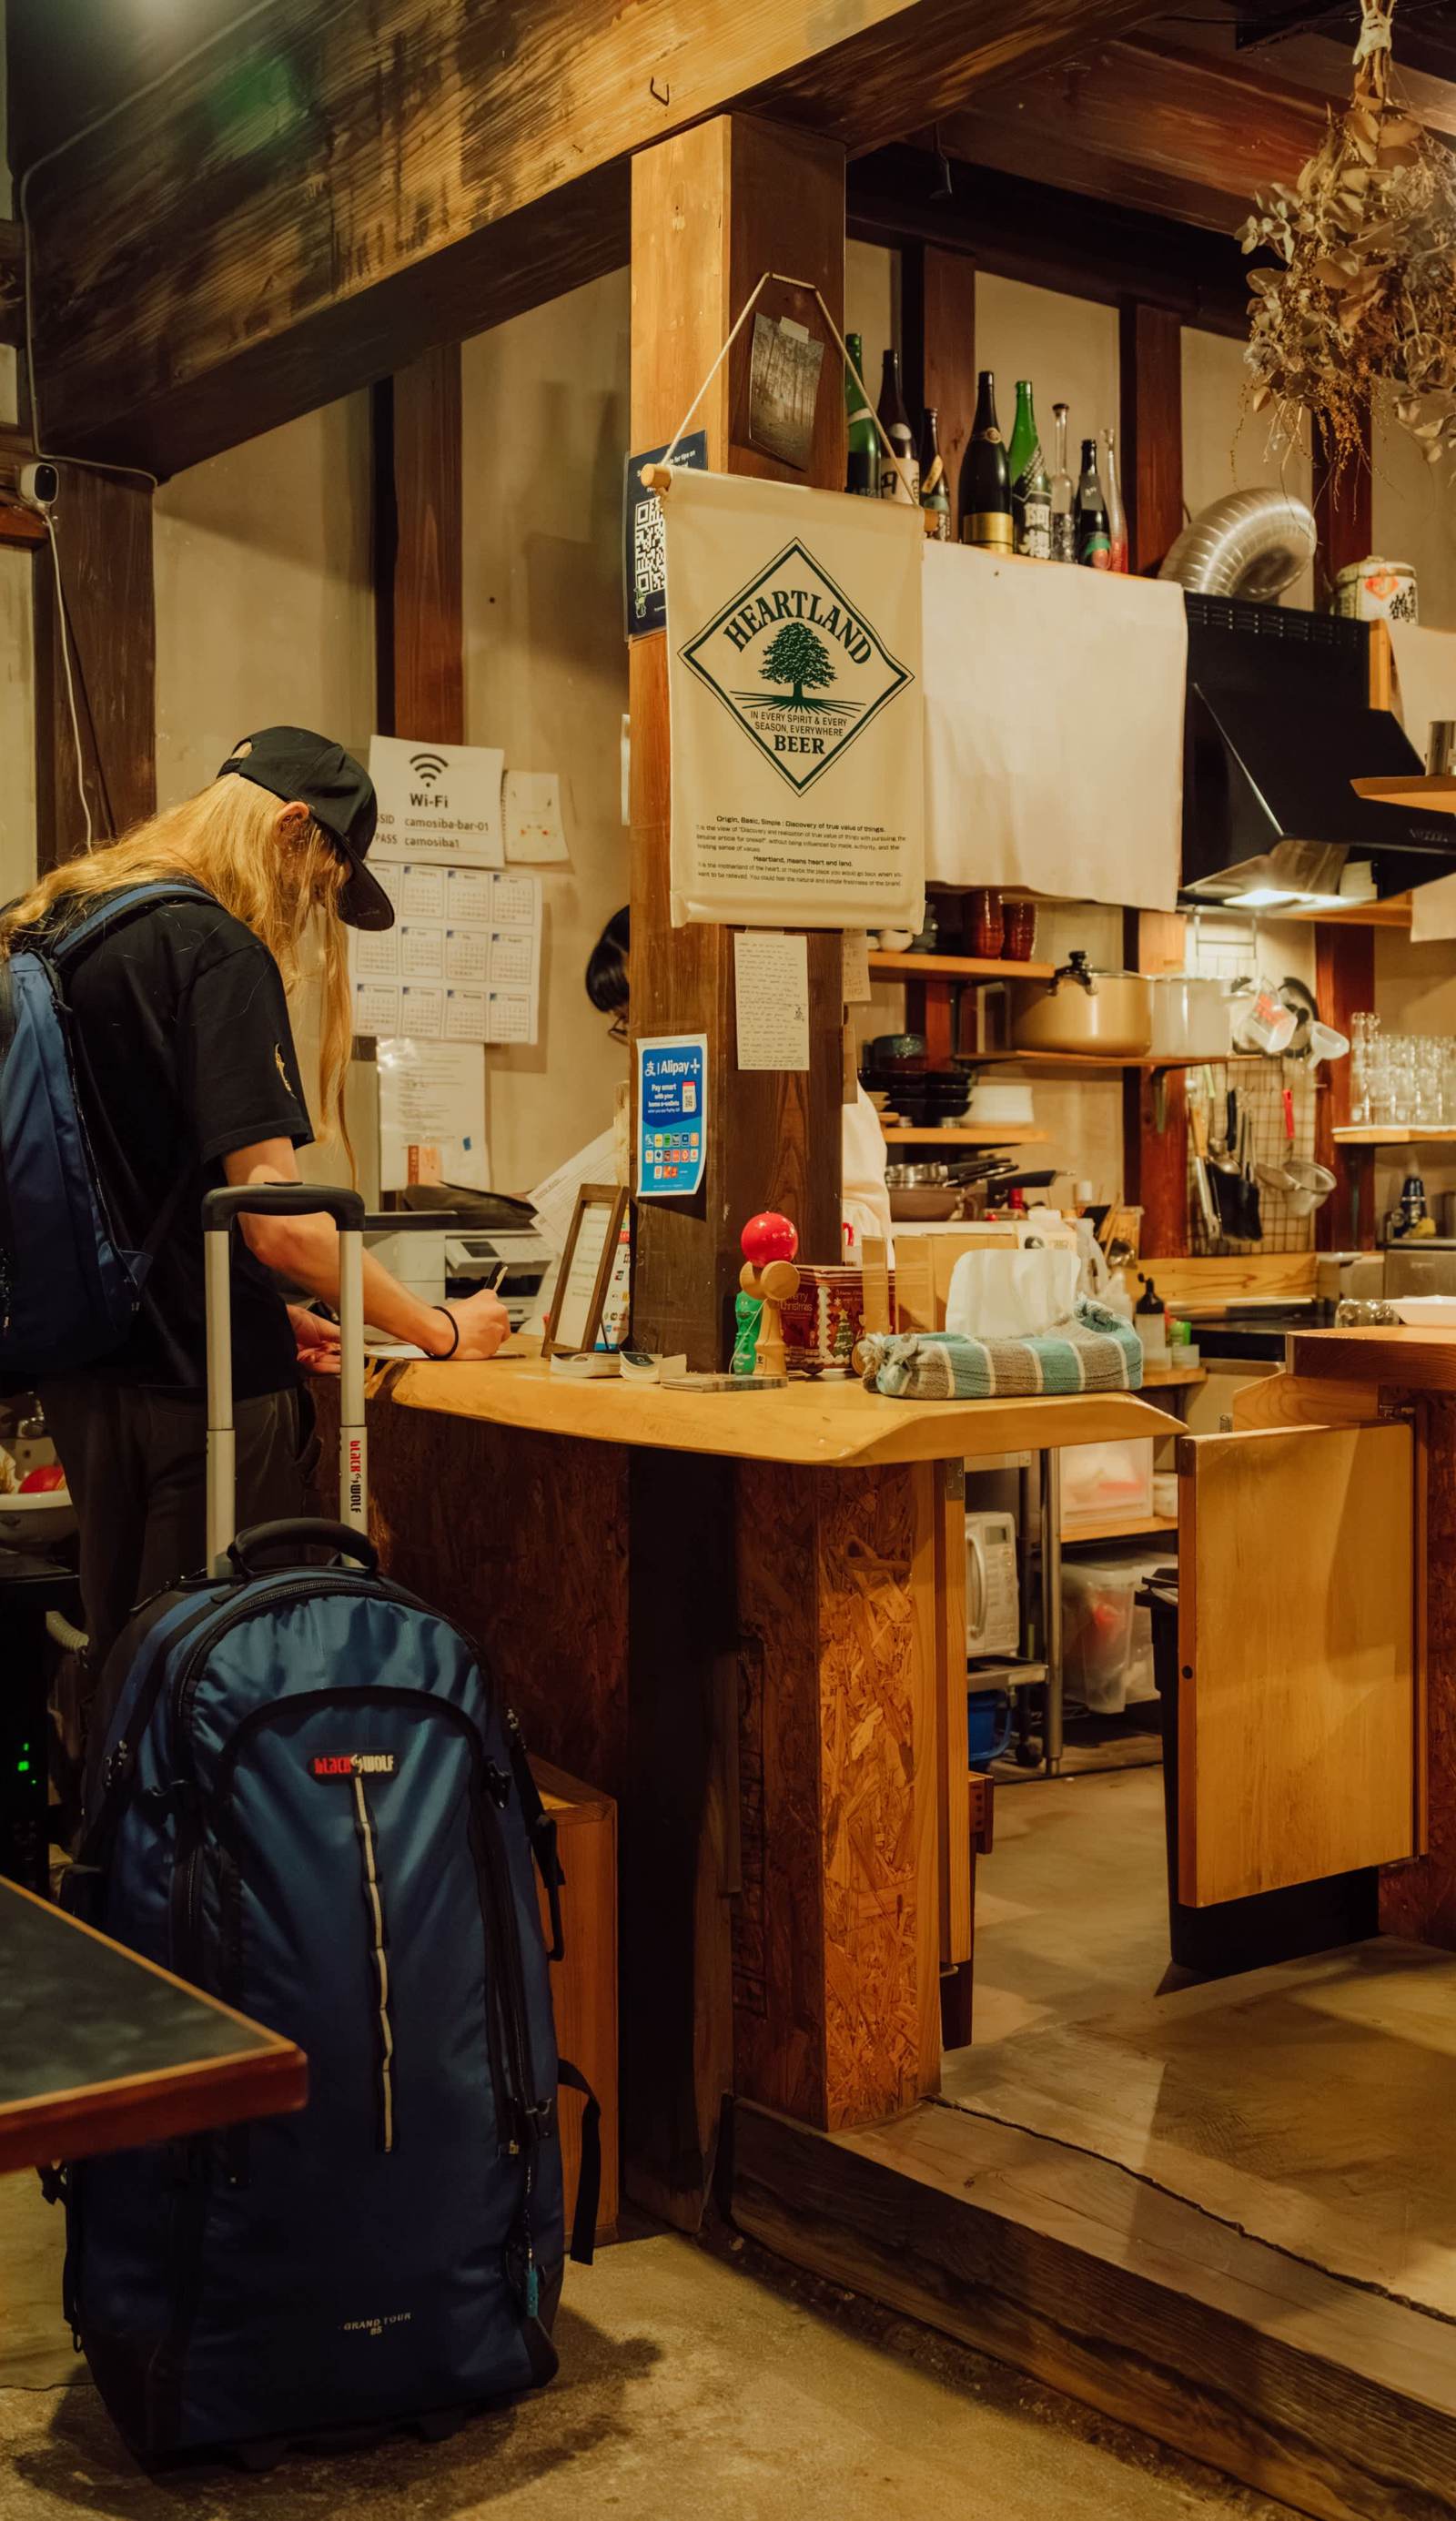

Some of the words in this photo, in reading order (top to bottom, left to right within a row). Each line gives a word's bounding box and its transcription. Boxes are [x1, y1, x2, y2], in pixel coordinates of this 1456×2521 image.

[723, 590, 872, 664] HEARTLAND
[750, 710, 759, 720] IN
[761, 711, 784, 722] EVERY
[787, 714, 812, 724] SPIRIT
[814, 715, 820, 724] &
[823, 716, 847, 727] EVERY
[791, 724, 844, 737] EVERYWHERE
[774, 734, 825, 754] BEER
[410, 793, 449, 808] Wi-Fi
[378, 814, 395, 825] SID
[716, 815, 740, 824] Origin,
[785, 821, 816, 829] Discovery
[375, 832, 398, 845] PASS
[344, 2318, 380, 2331] GRAND
[384, 2312, 412, 2325] TOUR
